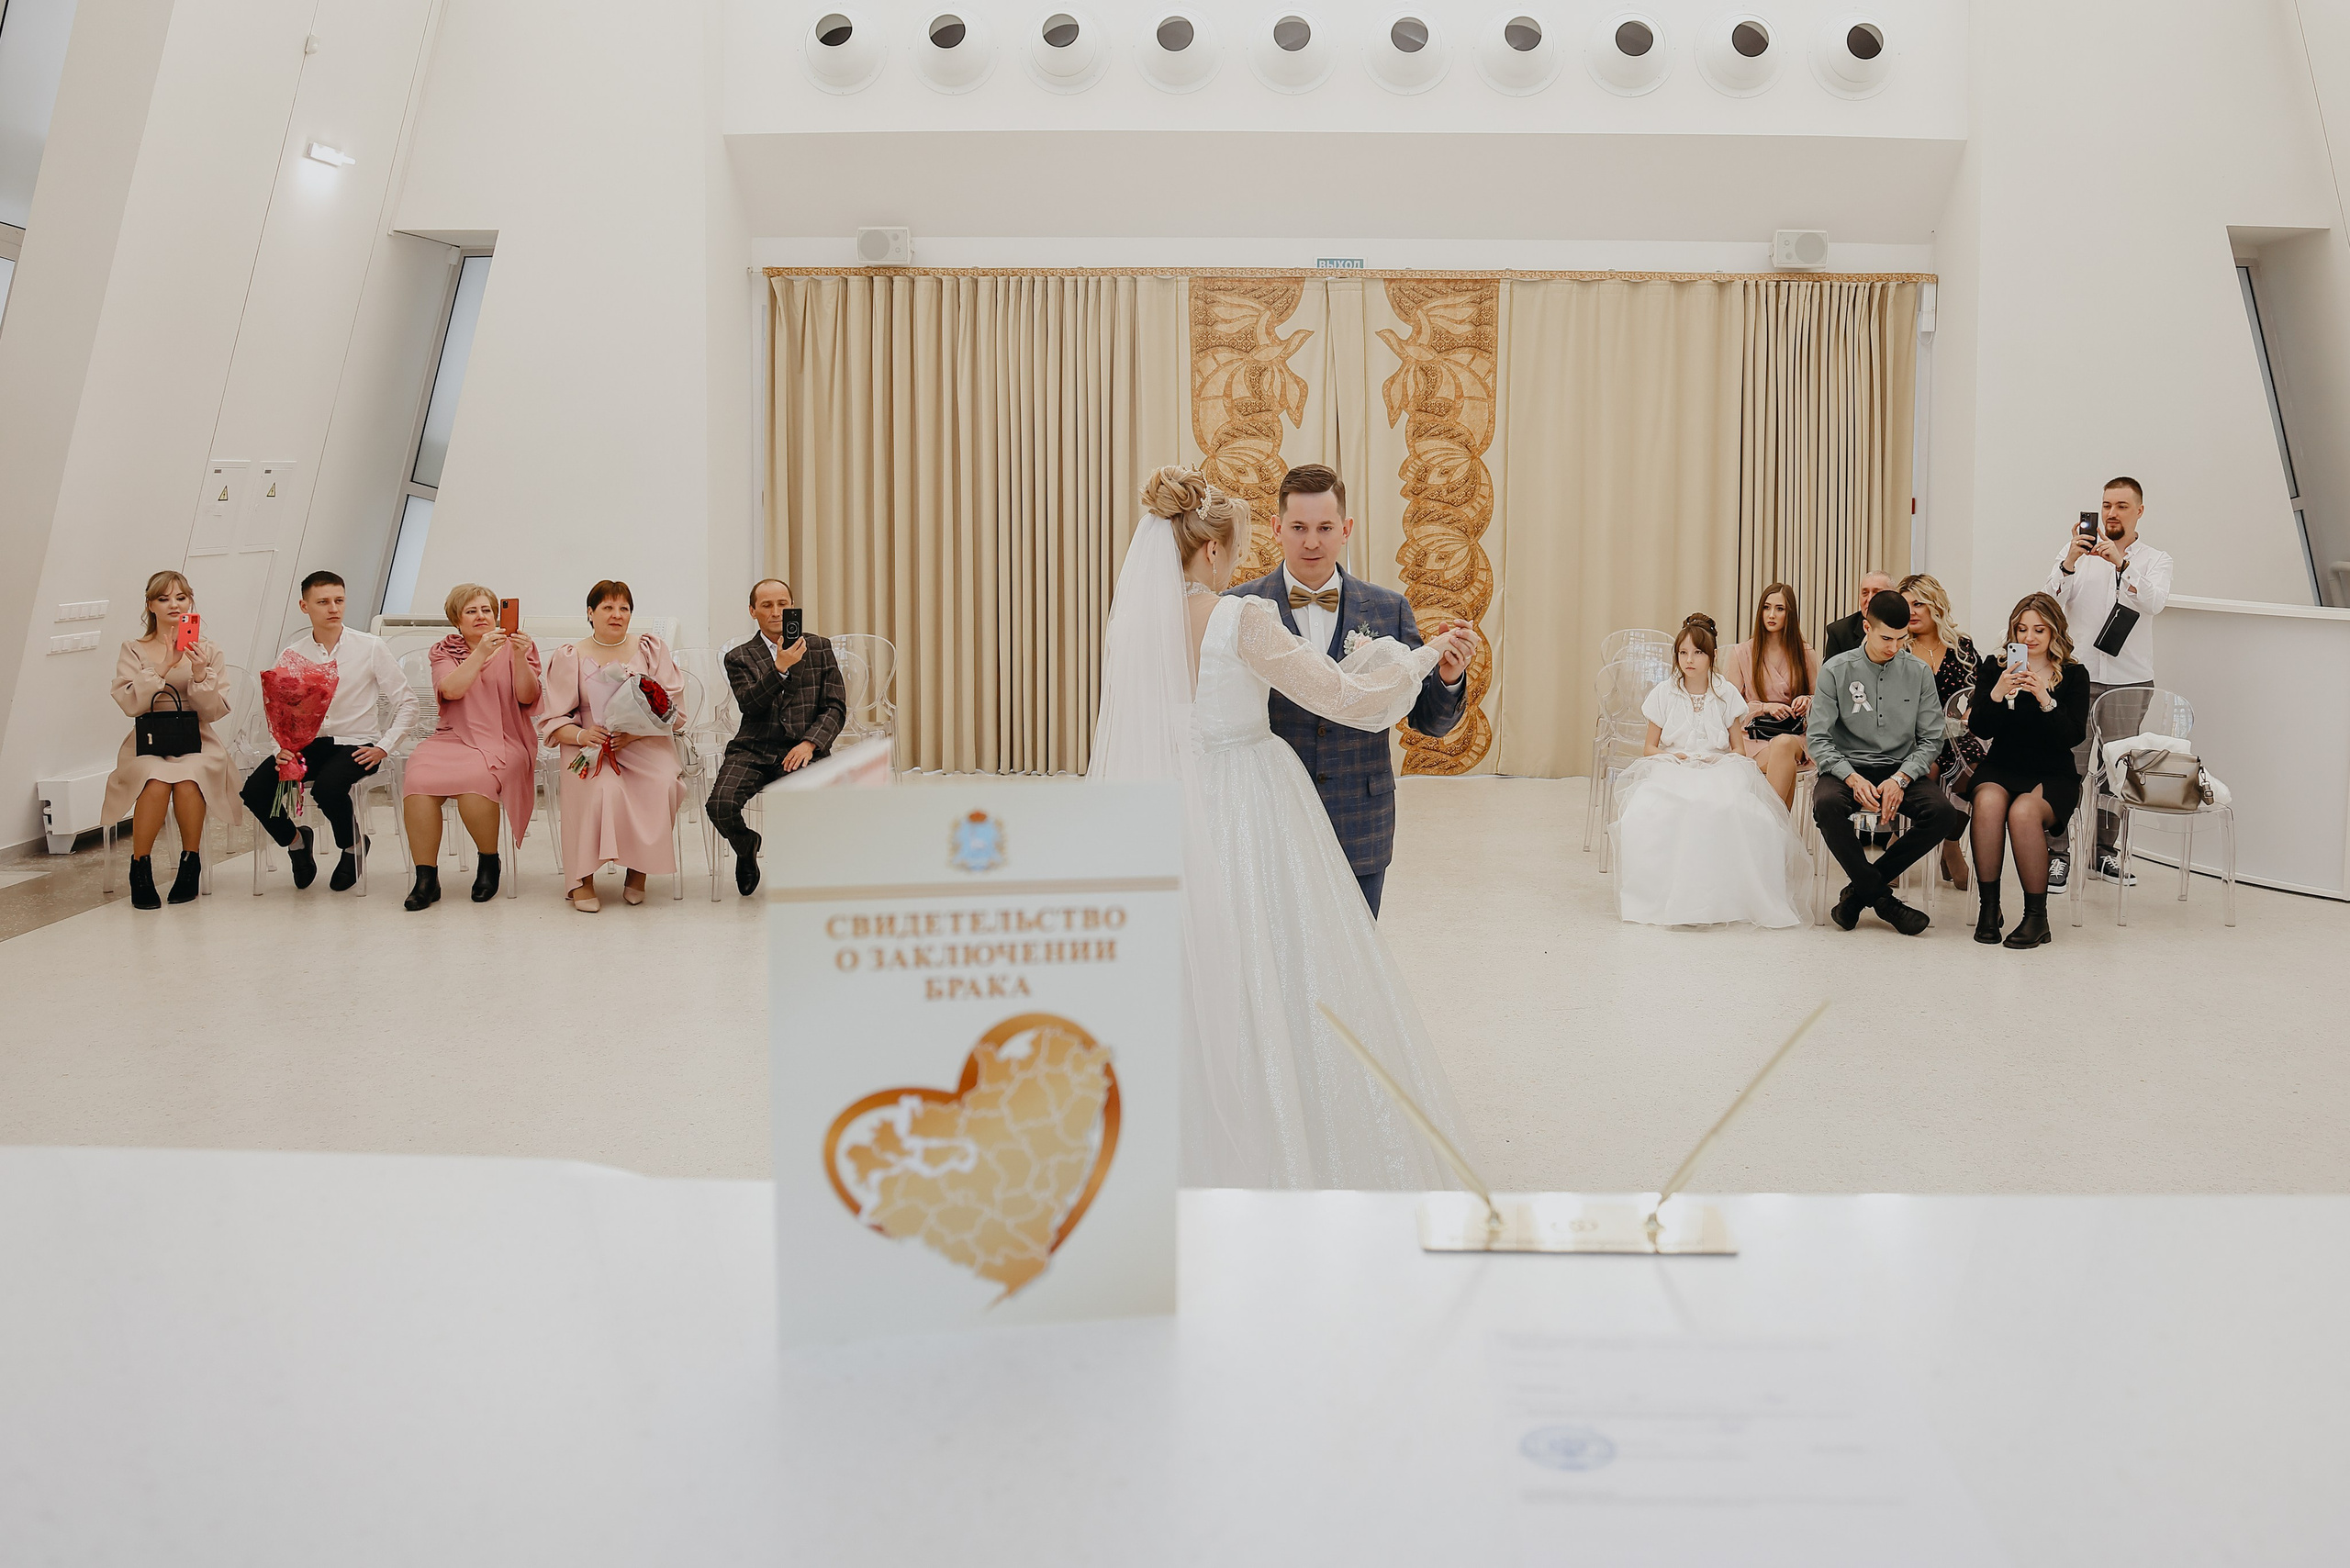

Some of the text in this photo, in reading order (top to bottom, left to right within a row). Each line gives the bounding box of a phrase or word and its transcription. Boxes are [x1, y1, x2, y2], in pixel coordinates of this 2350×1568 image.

[1318, 260, 1360, 268] ВЫХОД
[825, 905, 1127, 940] СВИДЕТЕЛЬСТВО
[834, 938, 1118, 973] О ЗАКЛЮЧЕНИИ
[924, 974, 1032, 1002] БРАКА
